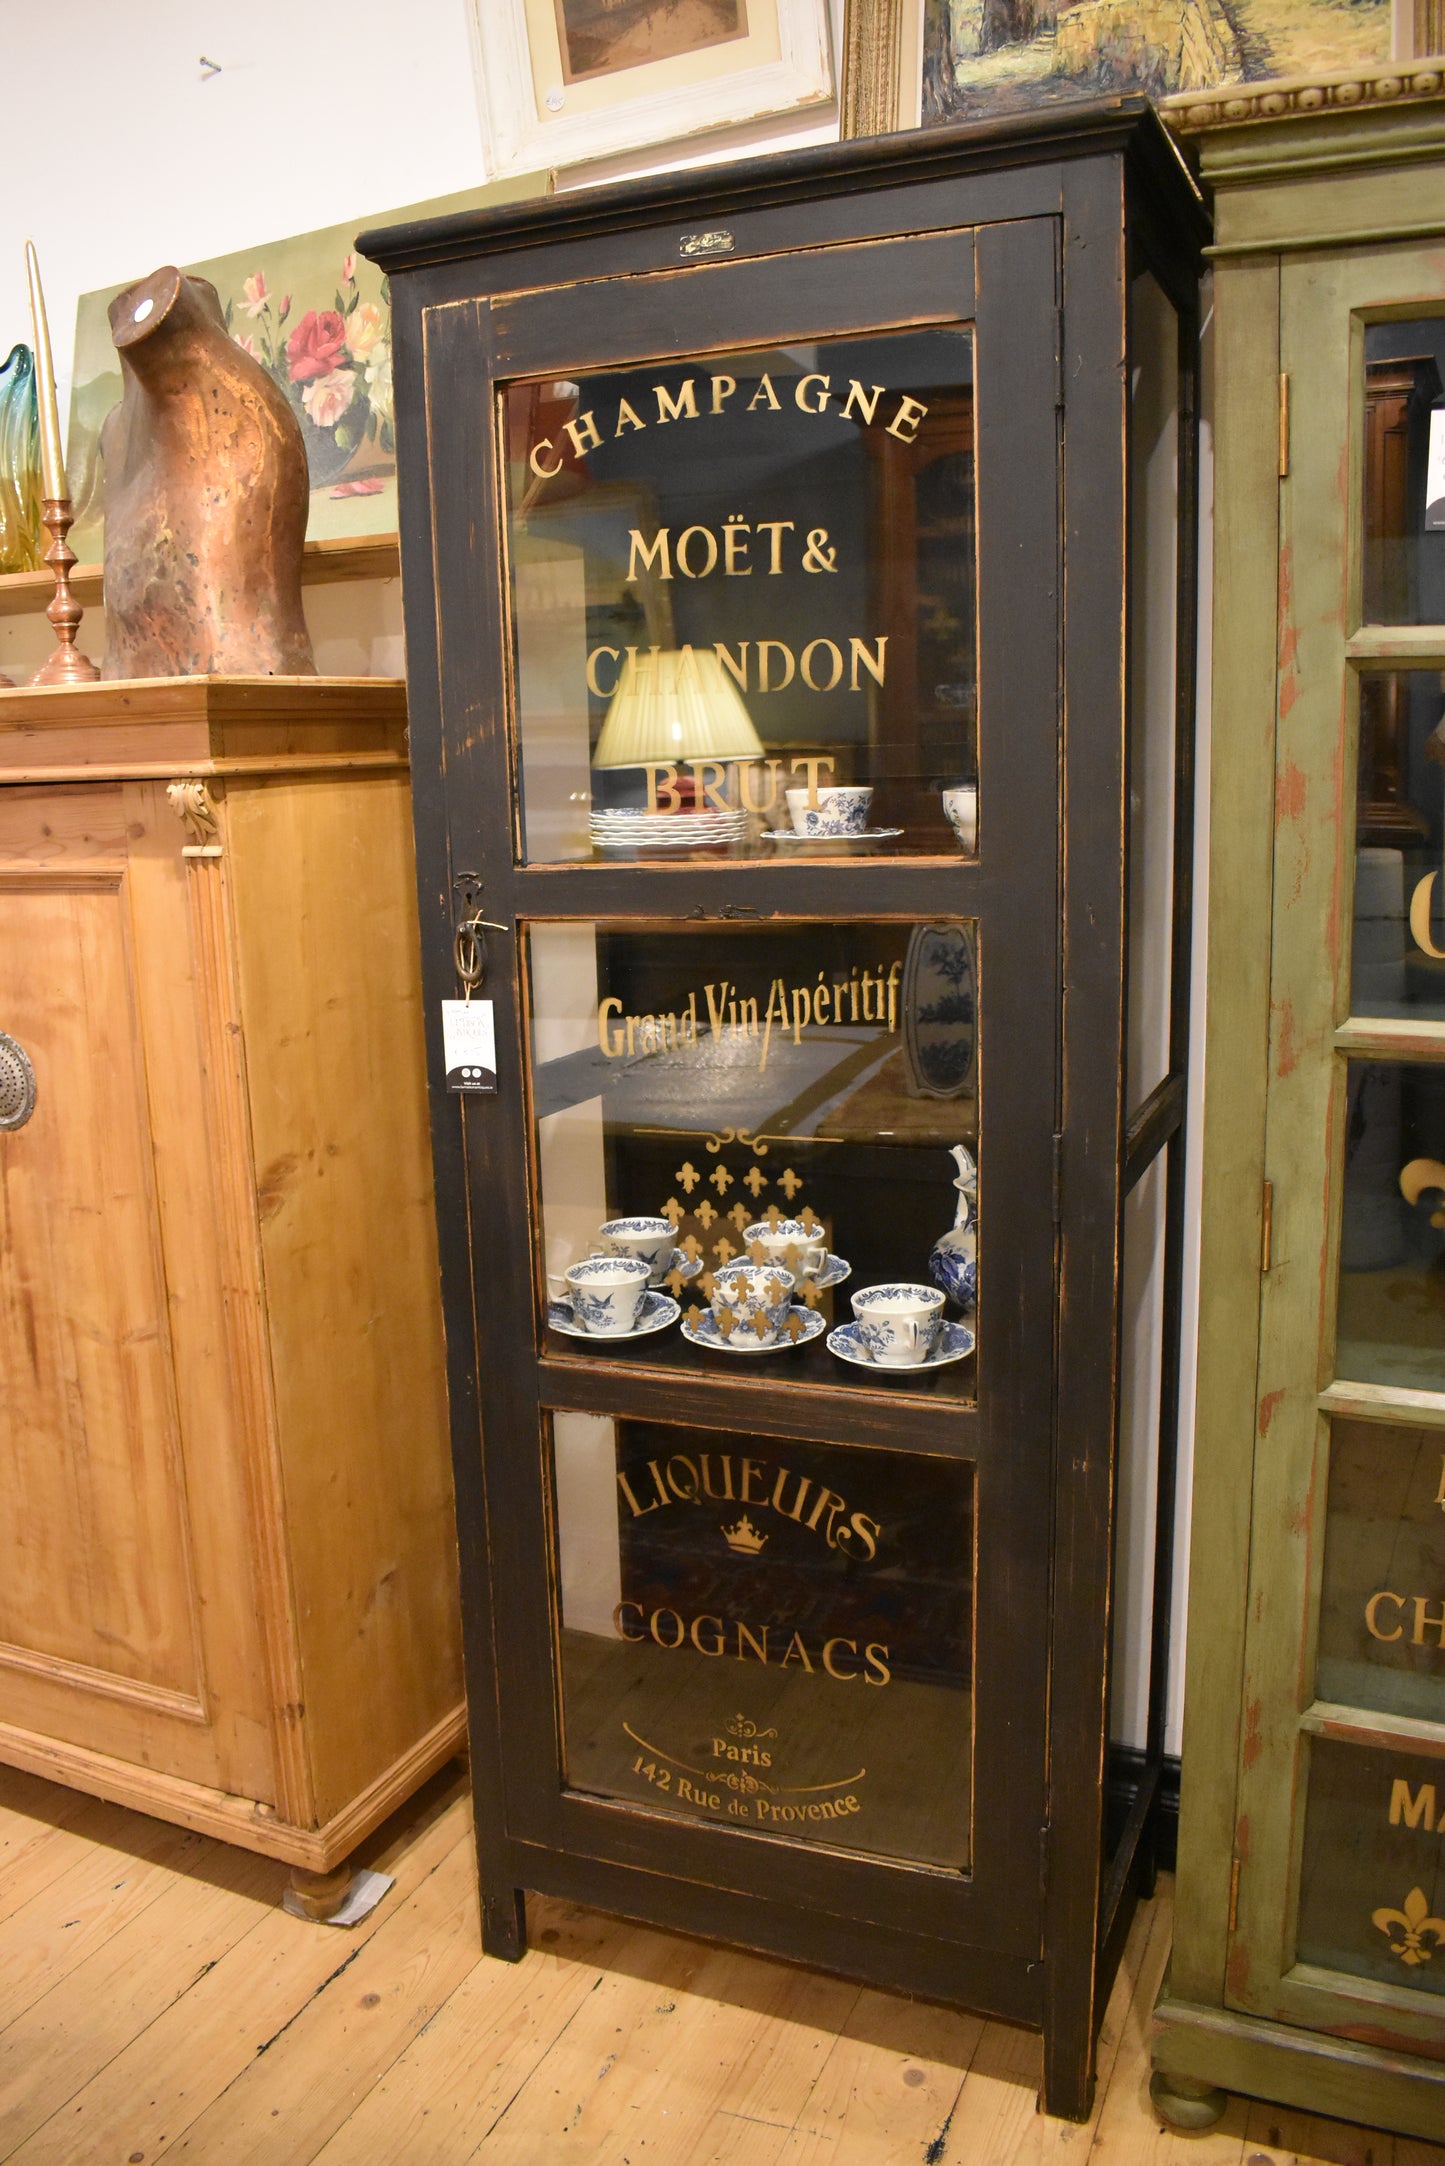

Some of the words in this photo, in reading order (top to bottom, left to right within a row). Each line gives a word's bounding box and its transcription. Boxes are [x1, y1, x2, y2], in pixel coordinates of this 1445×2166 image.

[529, 373, 928, 479] CHAMPAGNE
[626, 515, 794, 582] MOËT
[802, 528, 838, 574] &
[586, 637, 888, 699] CHANDON
[645, 757, 834, 816] BRUT
[599, 992, 698, 1057] Grand
[704, 981, 759, 1043] Vin
[759, 960, 902, 1072] Apéritif
[616, 1454, 882, 1562] LIQUEURS
[612, 1601, 891, 1687] COGNACS
[712, 1737, 772, 1768] Paris
[631, 1756, 671, 1792] 142
[677, 1777, 721, 1810] Rue
[727, 1799, 749, 1817] de
[756, 1795, 860, 1822] Provence
